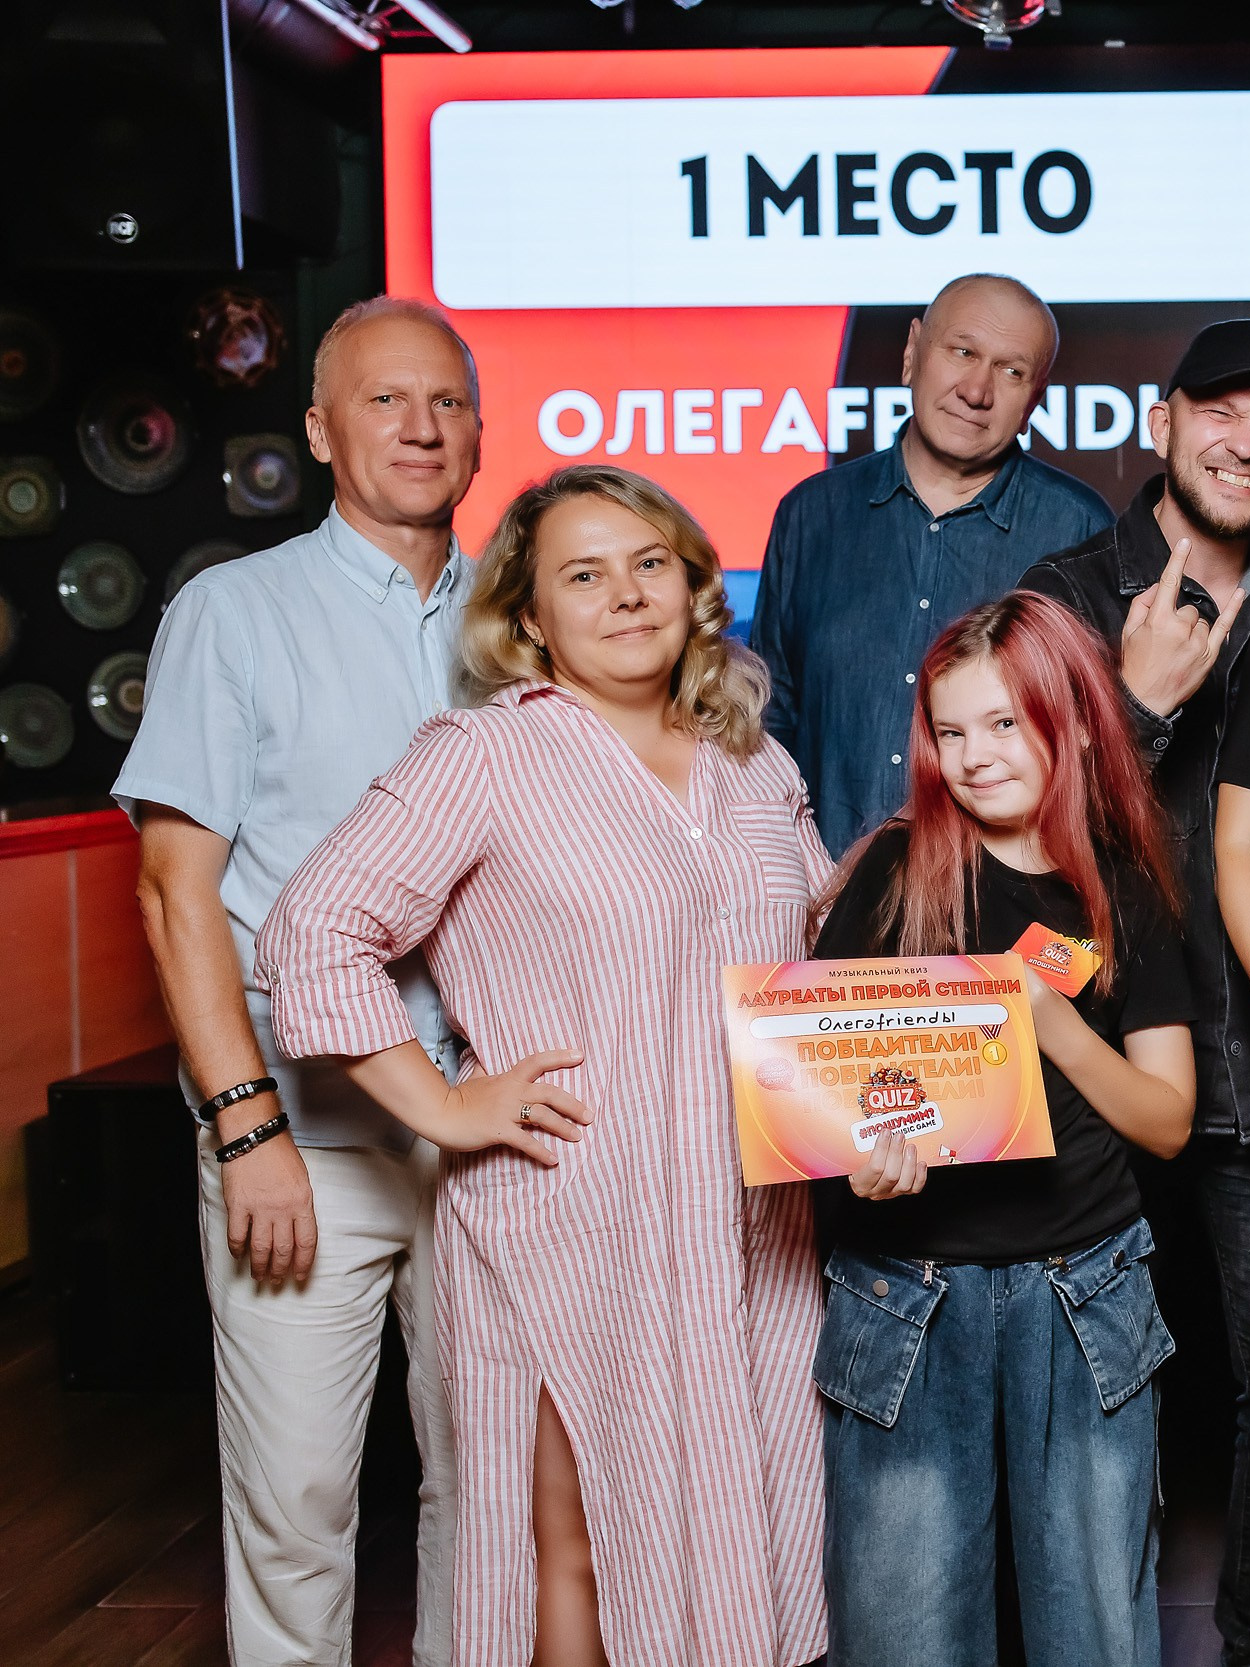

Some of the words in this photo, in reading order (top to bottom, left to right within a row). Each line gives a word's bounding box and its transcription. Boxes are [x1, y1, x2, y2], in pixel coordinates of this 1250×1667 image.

[681, 154, 709, 238] 1
[746, 150, 1092, 237] МЕСТО
[1045, 948, 1067, 964] QUIZ
[829, 966, 901, 978] МУЗЫКАЛЬНЫЙ
[903, 967, 928, 975] КВИЗ
[1028, 958, 1069, 975] #ПОШУМИМ?
[738, 986, 847, 1009] ЛАУРЕАТЫ
[851, 979, 931, 1001] ПЕРВОЙ
[935, 979, 1022, 997] СТЕПЕНИ
[797, 1032, 978, 1062] ПОБЕДИТЕЛИ!
[868, 1088, 916, 1109] QUIZ
[916, 1119, 937, 1130] GAME
